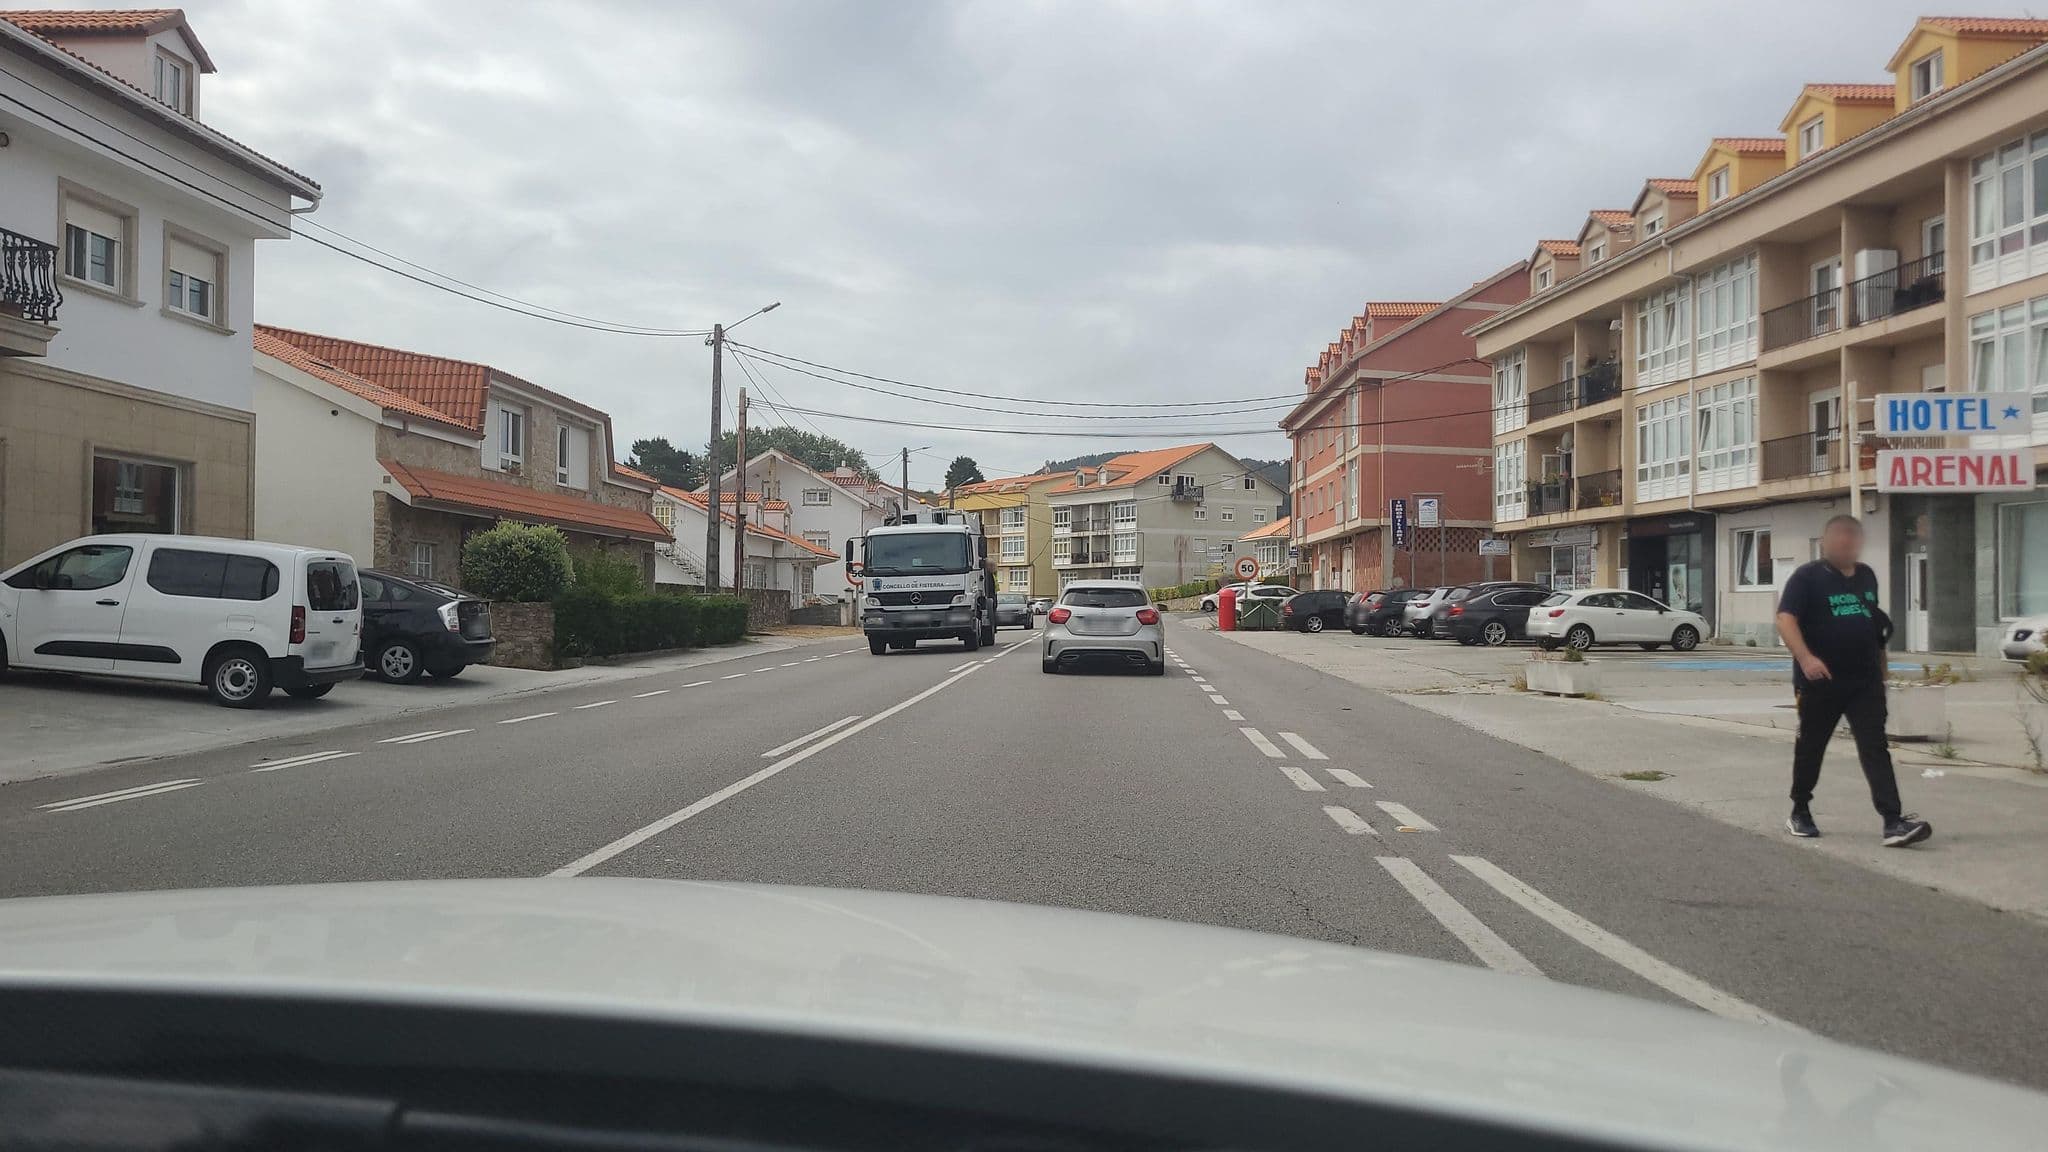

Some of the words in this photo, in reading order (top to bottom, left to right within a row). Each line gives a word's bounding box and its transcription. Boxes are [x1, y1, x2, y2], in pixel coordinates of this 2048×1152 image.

[1888, 398, 1996, 432] HOTEL
[1889, 455, 2027, 486] ARENAL
[1241, 564, 1254, 573] 50
